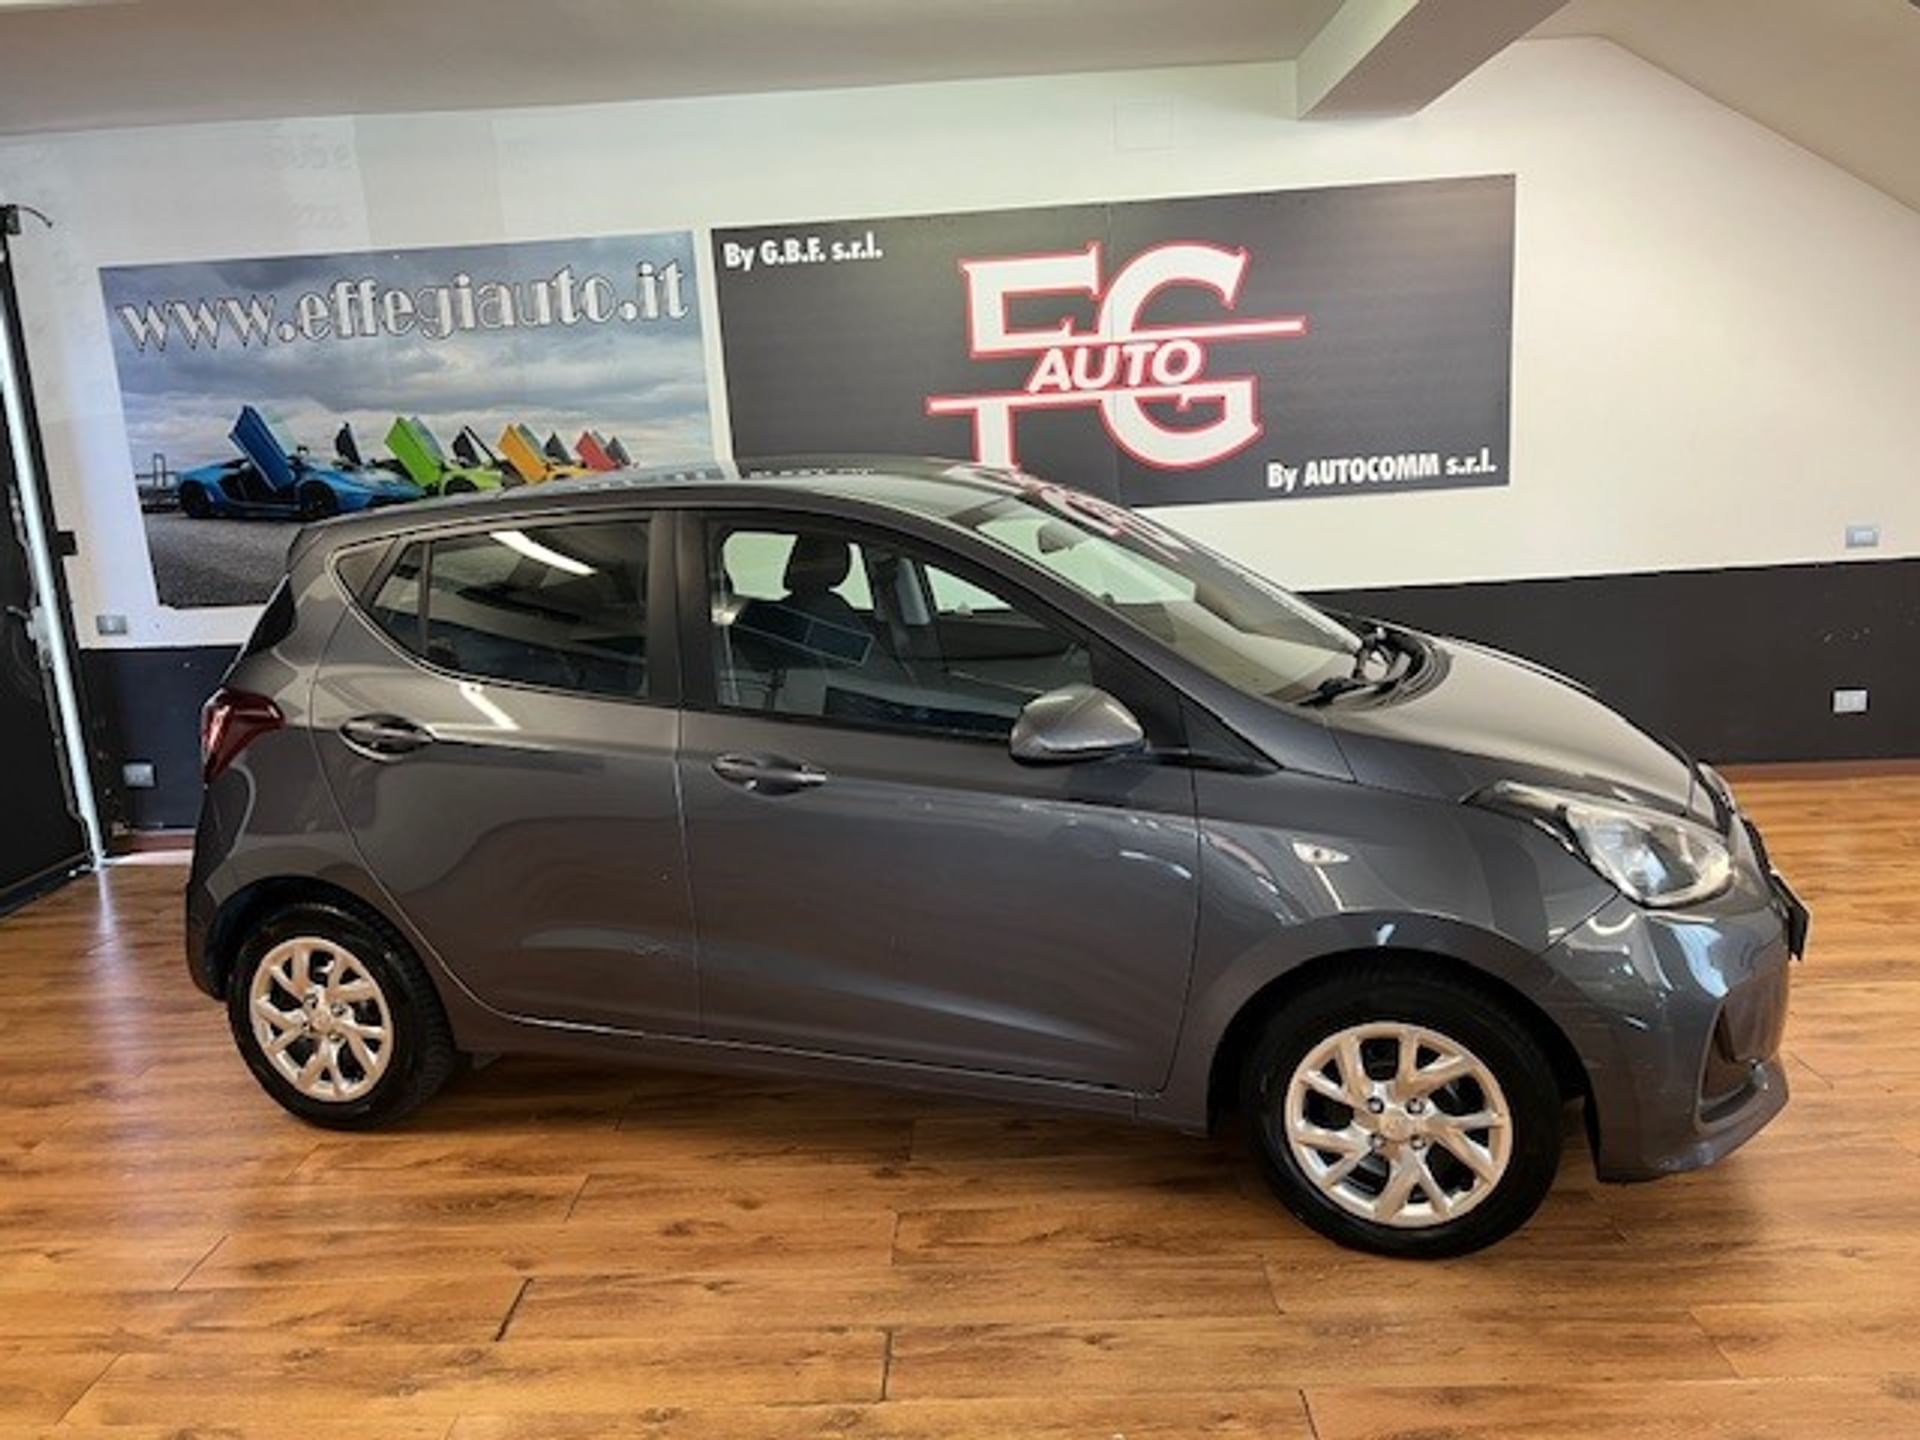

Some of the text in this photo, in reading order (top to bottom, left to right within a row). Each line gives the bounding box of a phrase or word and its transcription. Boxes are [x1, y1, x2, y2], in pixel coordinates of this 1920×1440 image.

[723, 231, 884, 271] By G.B.F. s.r.l.
[115, 259, 688, 352] www.effegiauto.it
[1027, 338, 1203, 392] AUTO
[1267, 448, 1497, 492] By AUTOCOMM s.r.l.
